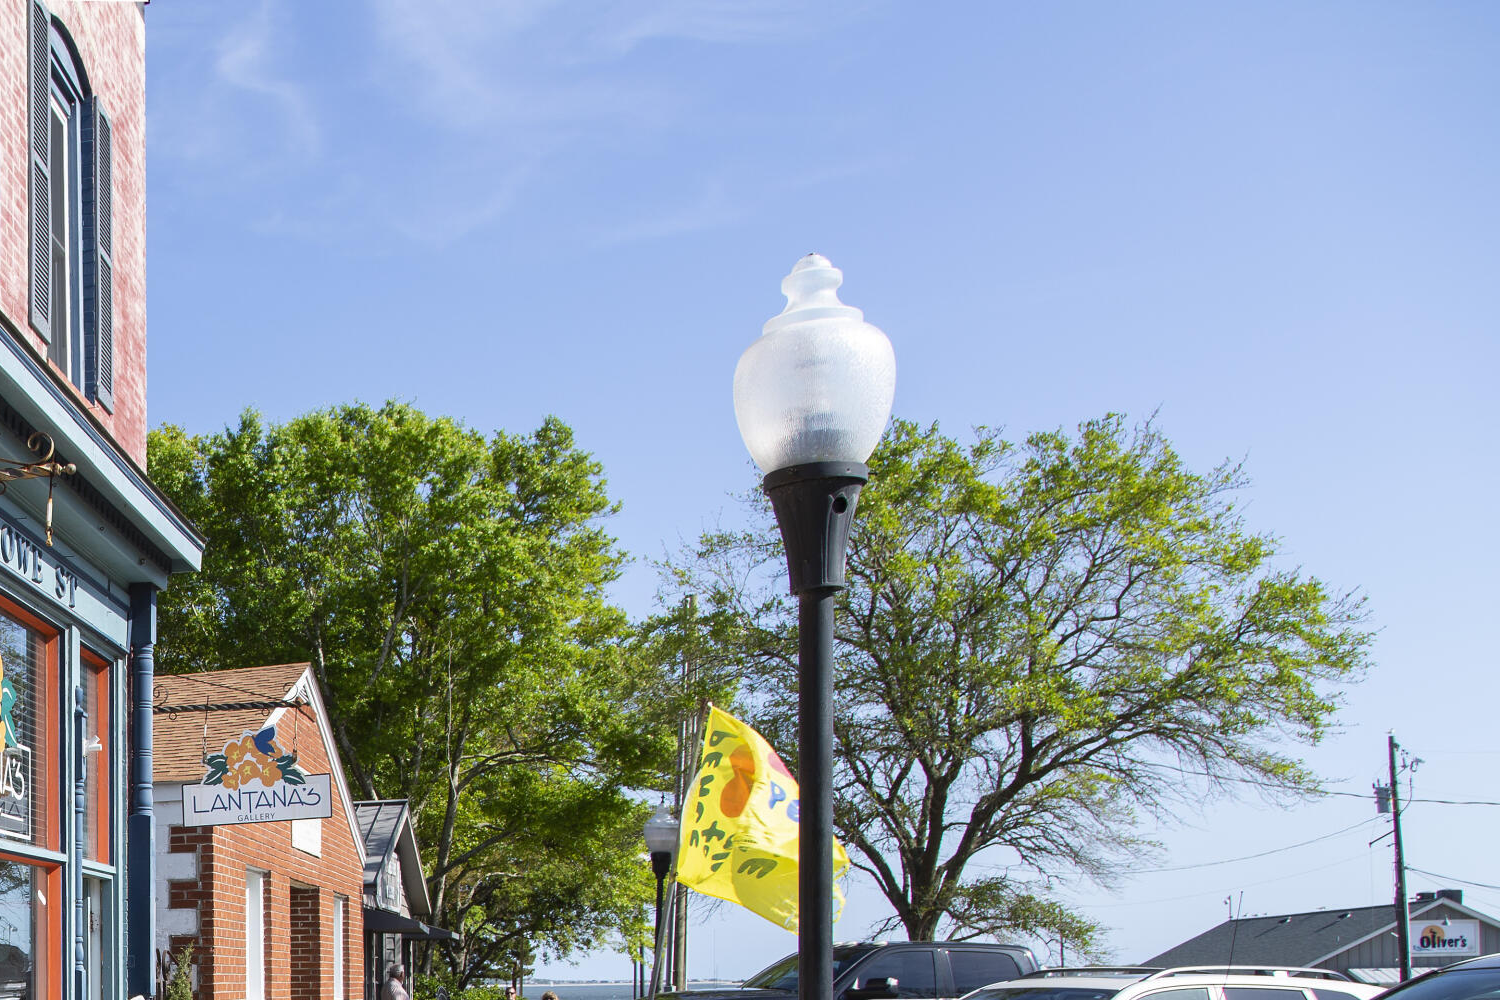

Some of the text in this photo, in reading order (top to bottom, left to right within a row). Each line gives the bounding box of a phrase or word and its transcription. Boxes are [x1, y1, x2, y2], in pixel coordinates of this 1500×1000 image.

[55, 565, 78, 608] ST
[193, 785, 322, 815] LANTANA'S
[237, 812, 276, 822] GALLERY
[1420, 931, 1467, 949] Oliver's
